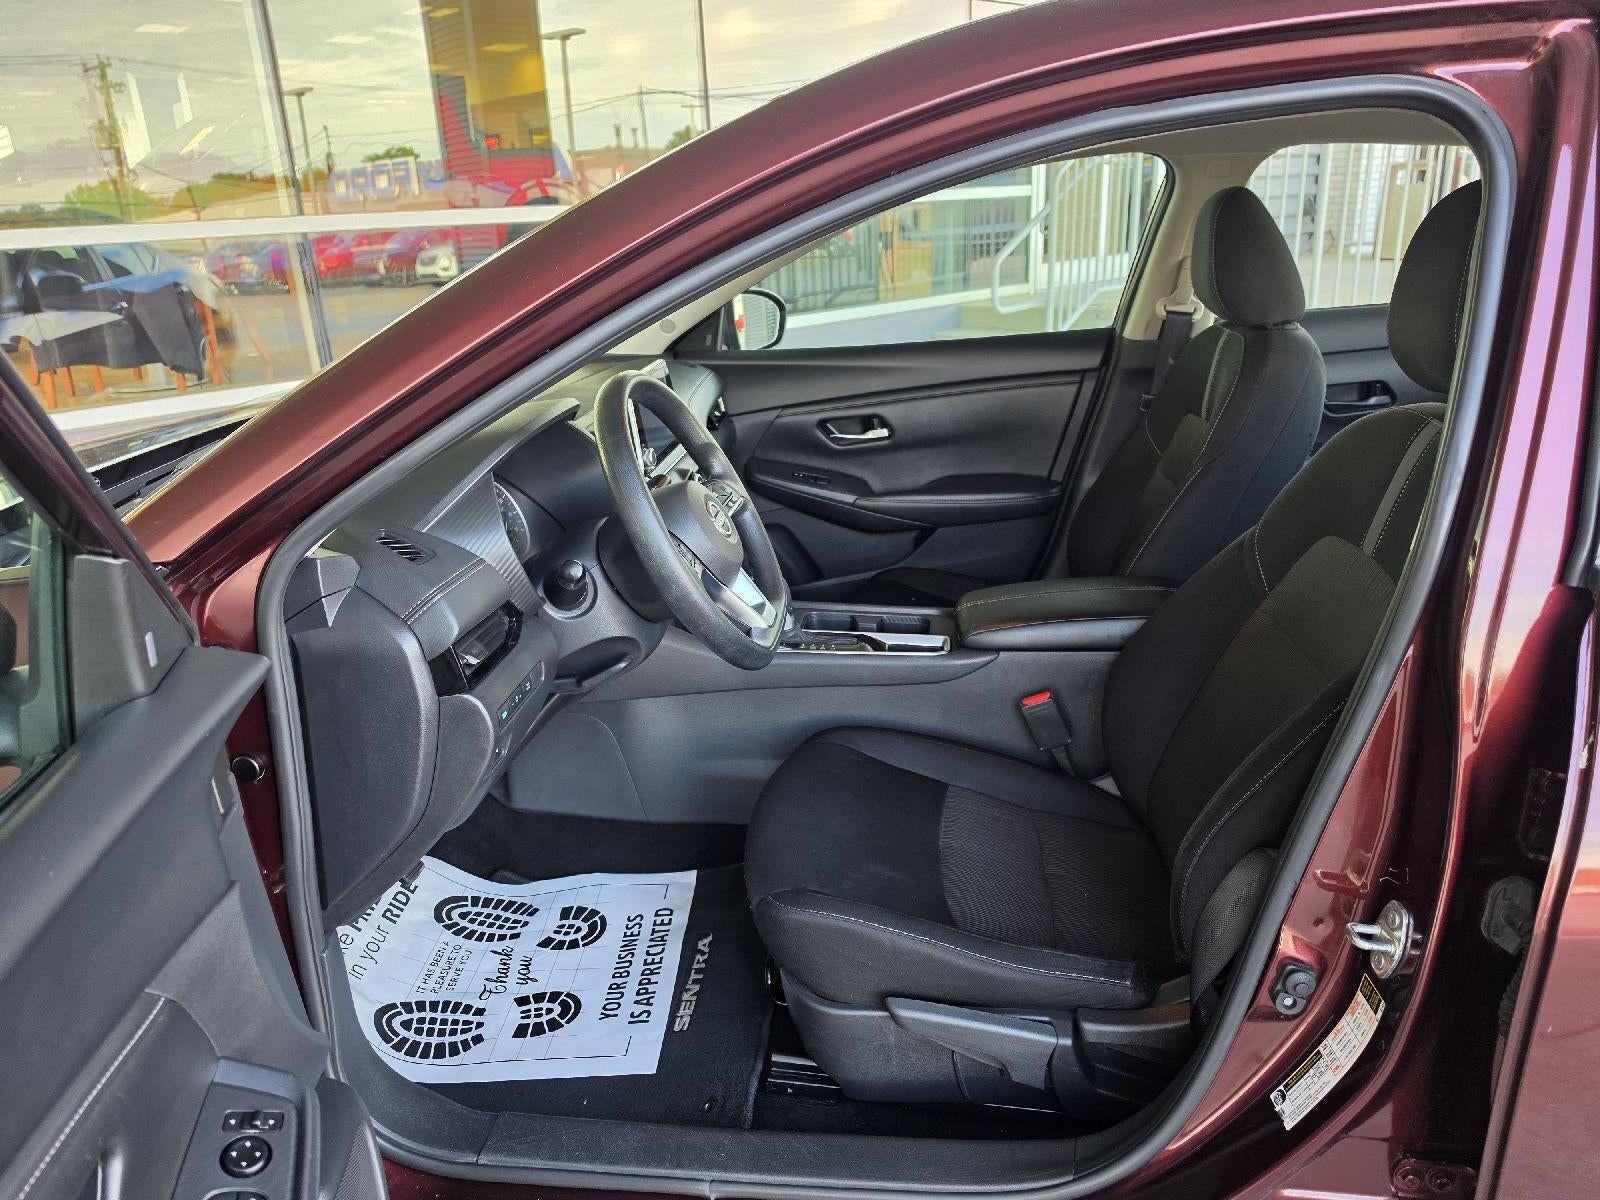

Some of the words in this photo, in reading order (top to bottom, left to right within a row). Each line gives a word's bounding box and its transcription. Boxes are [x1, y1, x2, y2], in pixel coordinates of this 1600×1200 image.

[381, 880, 419, 925] RIDE
[358, 925, 389, 965] your
[422, 968, 435, 985] HAS
[430, 946, 447, 968] BEEN
[612, 913, 644, 979] BUSINESS
[633, 907, 674, 1007] APPRECIATED
[349, 963, 368, 981] in
[430, 956, 457, 994] PLEASURE
[450, 944, 462, 955] TO
[445, 967, 464, 991] SERVE
[459, 949, 472, 965] YOU
[479, 945, 514, 1001] Thank
[516, 955, 538, 985] you
[673, 932, 713, 1032] SENTRA
[598, 980, 629, 1020] YOUR
[627, 1009, 652, 1025] IS
